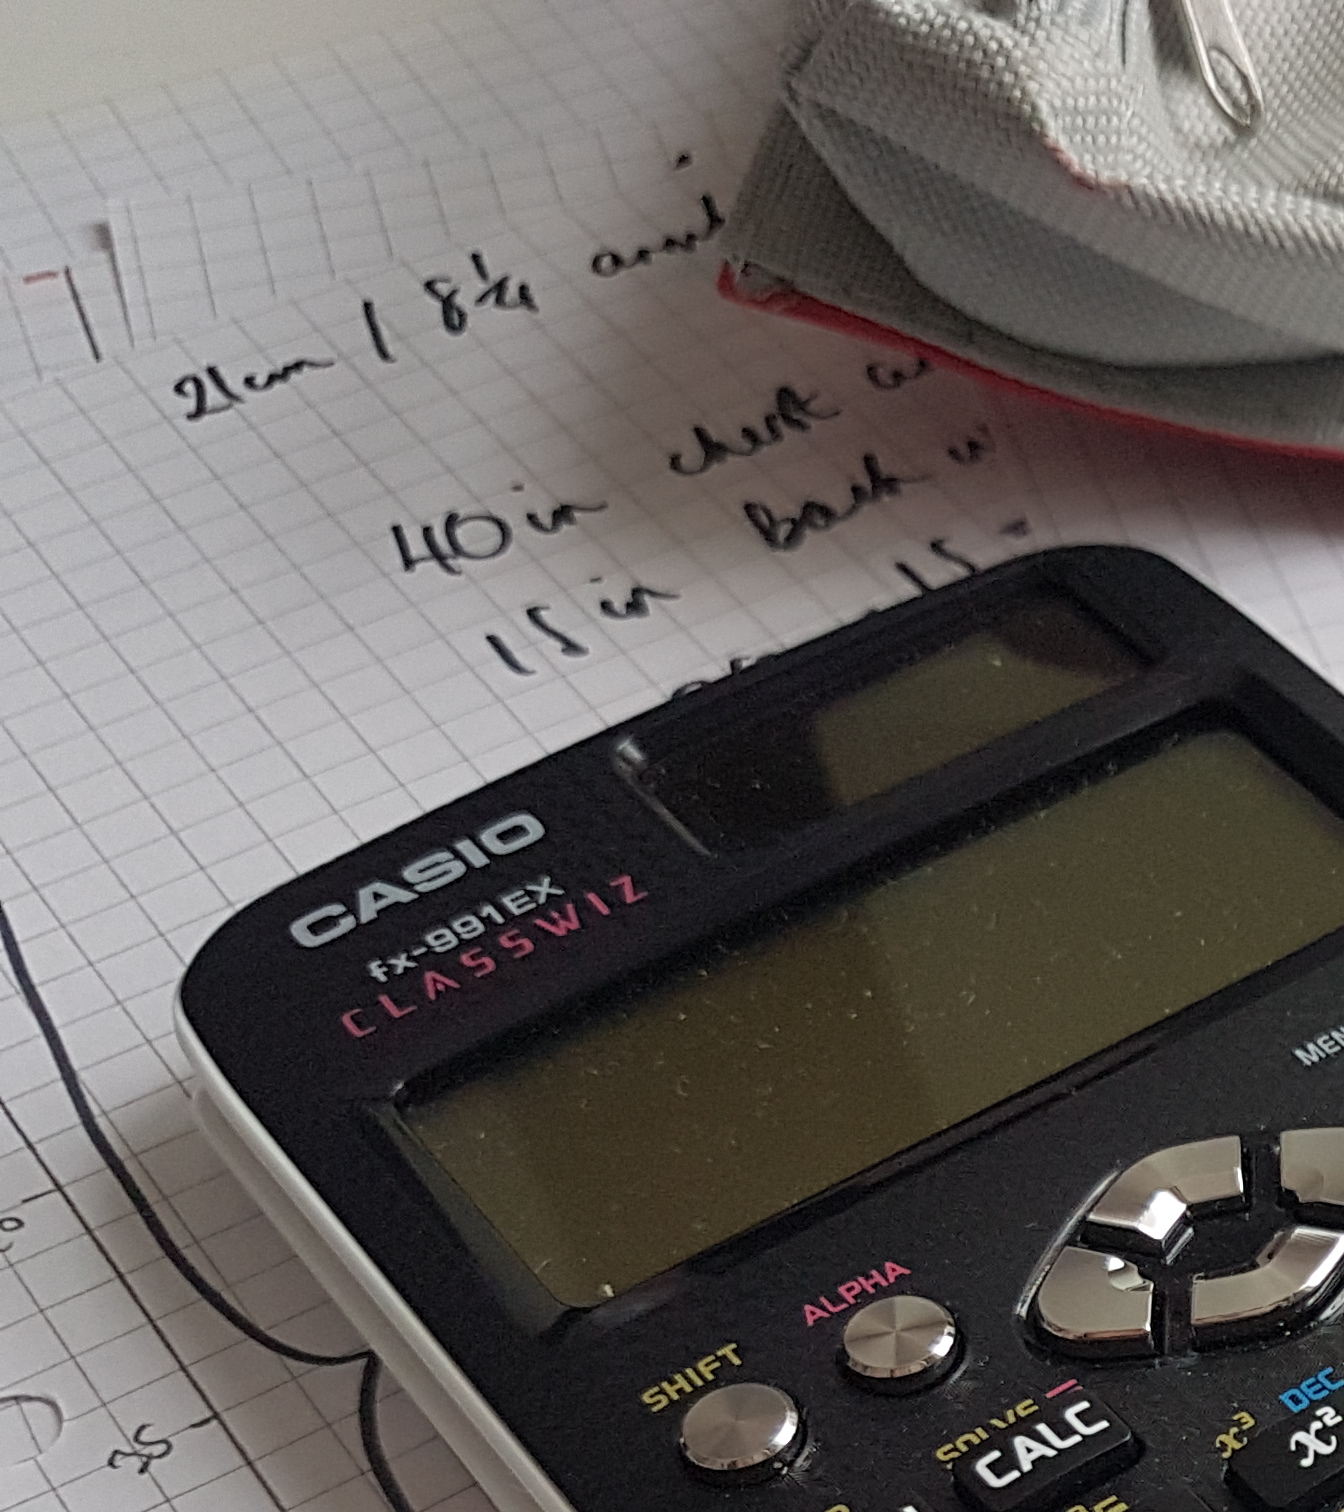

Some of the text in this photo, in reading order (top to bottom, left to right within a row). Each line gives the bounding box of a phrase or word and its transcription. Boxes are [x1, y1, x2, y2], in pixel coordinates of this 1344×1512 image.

[290, 812, 546, 948] CASIO
[368, 876, 564, 982] fx-991EX
[341, 875, 649, 1038] CLASSWIZ
[803, 1260, 911, 1326] ALPHA
[641, 1343, 744, 1413] SHIFT
[974, 1399, 1110, 1489] CALC
